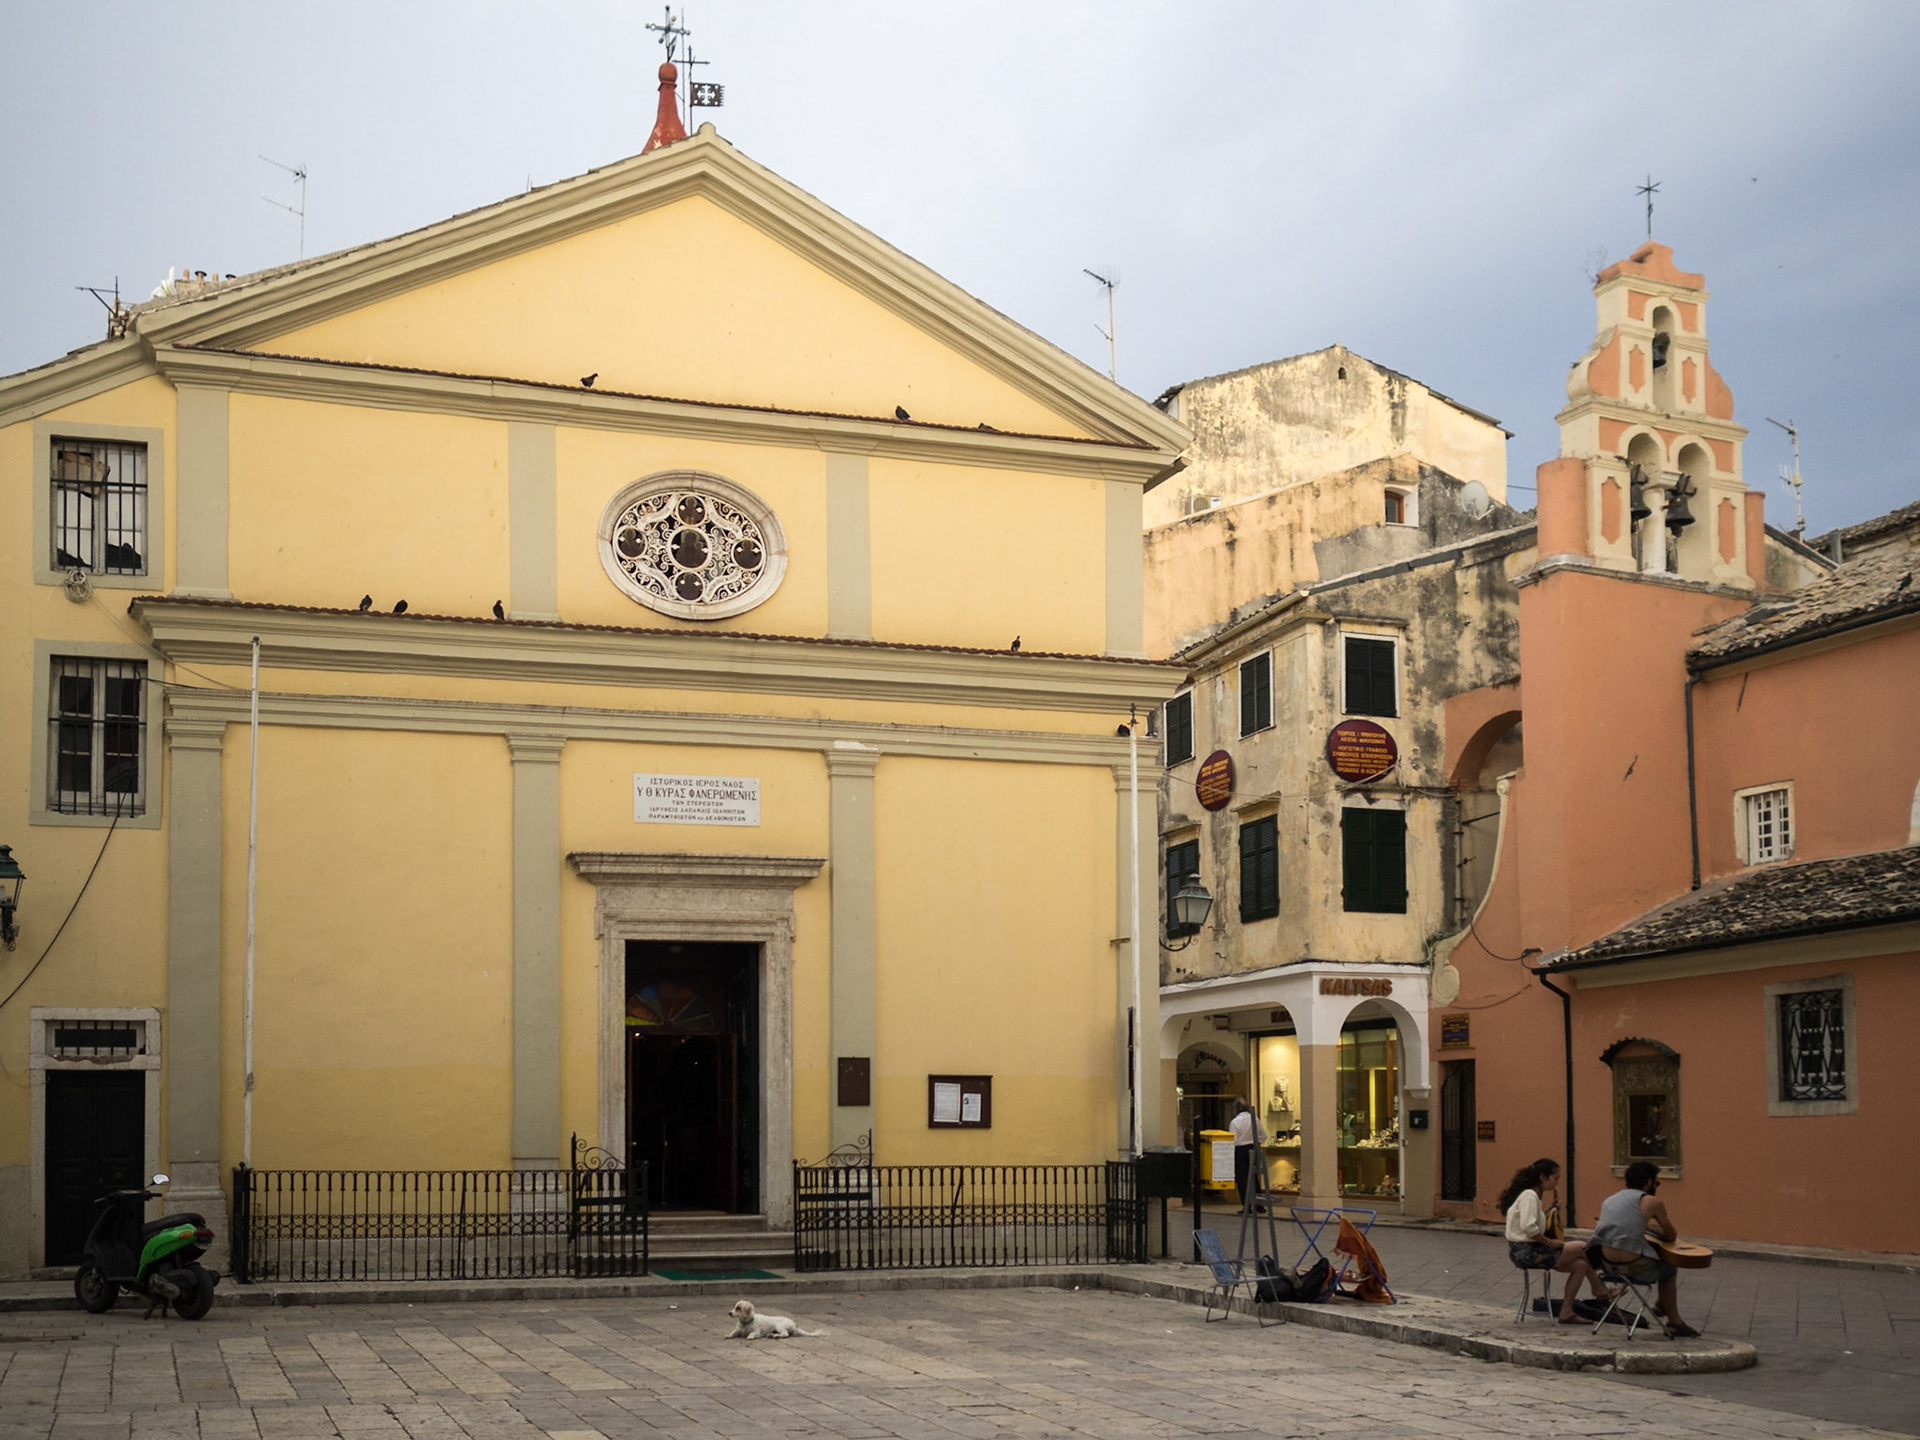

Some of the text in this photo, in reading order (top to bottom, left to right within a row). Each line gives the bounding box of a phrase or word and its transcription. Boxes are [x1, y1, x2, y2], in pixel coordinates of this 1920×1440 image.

[650, 778, 744, 788] ΙΣΤΟΡΙΚΟΣ ΙΕΡΟΣ ΝΑΟΣ
[646, 787, 653, 797] Θ
[655, 787, 686, 798] ΚΥΡΑΣ
[689, 788, 757, 801] ΦΑΝΕΡΩΜΕΝΗΣ
[1319, 977, 1393, 996] KALTSAS
